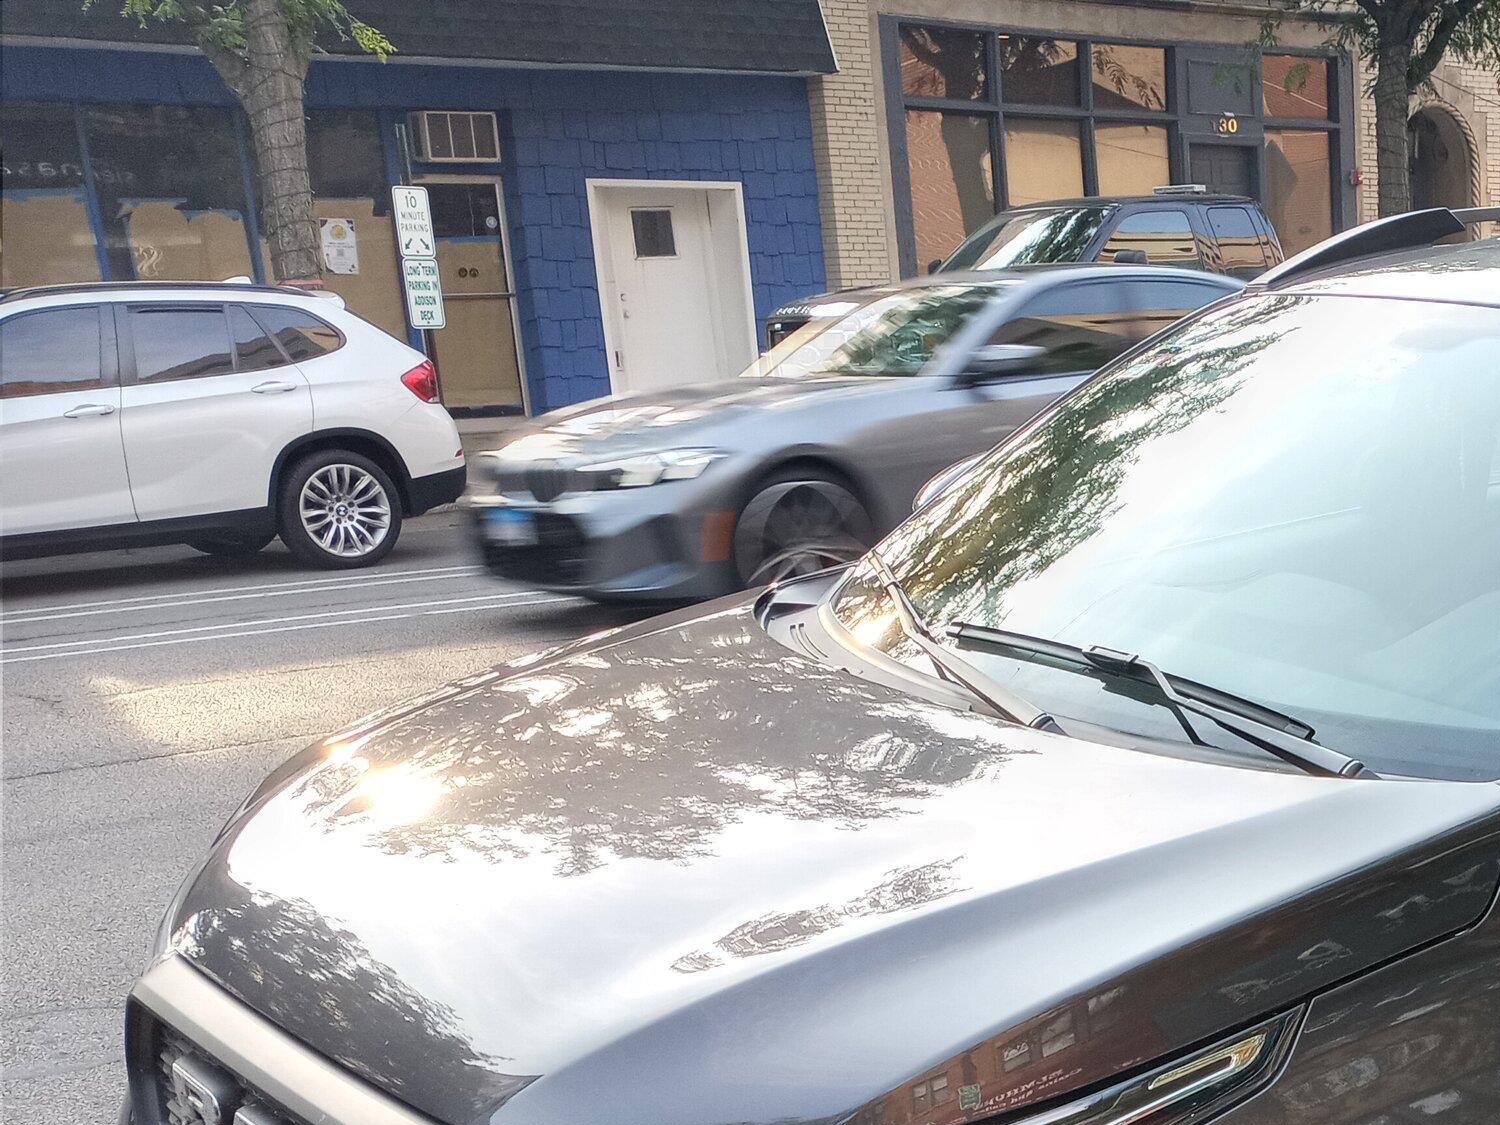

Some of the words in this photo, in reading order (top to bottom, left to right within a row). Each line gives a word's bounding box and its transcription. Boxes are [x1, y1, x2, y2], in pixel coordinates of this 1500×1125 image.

[404, 195, 417, 208] 10
[400, 211, 426, 221] MINUTE
[400, 223, 429, 233] PARKING
[407, 265, 421, 276] LONG
[421, 265, 438, 276] TERM
[408, 280, 431, 291] PARKING
[414, 295, 437, 306] ADDISON
[420, 310, 434, 321] DECK
